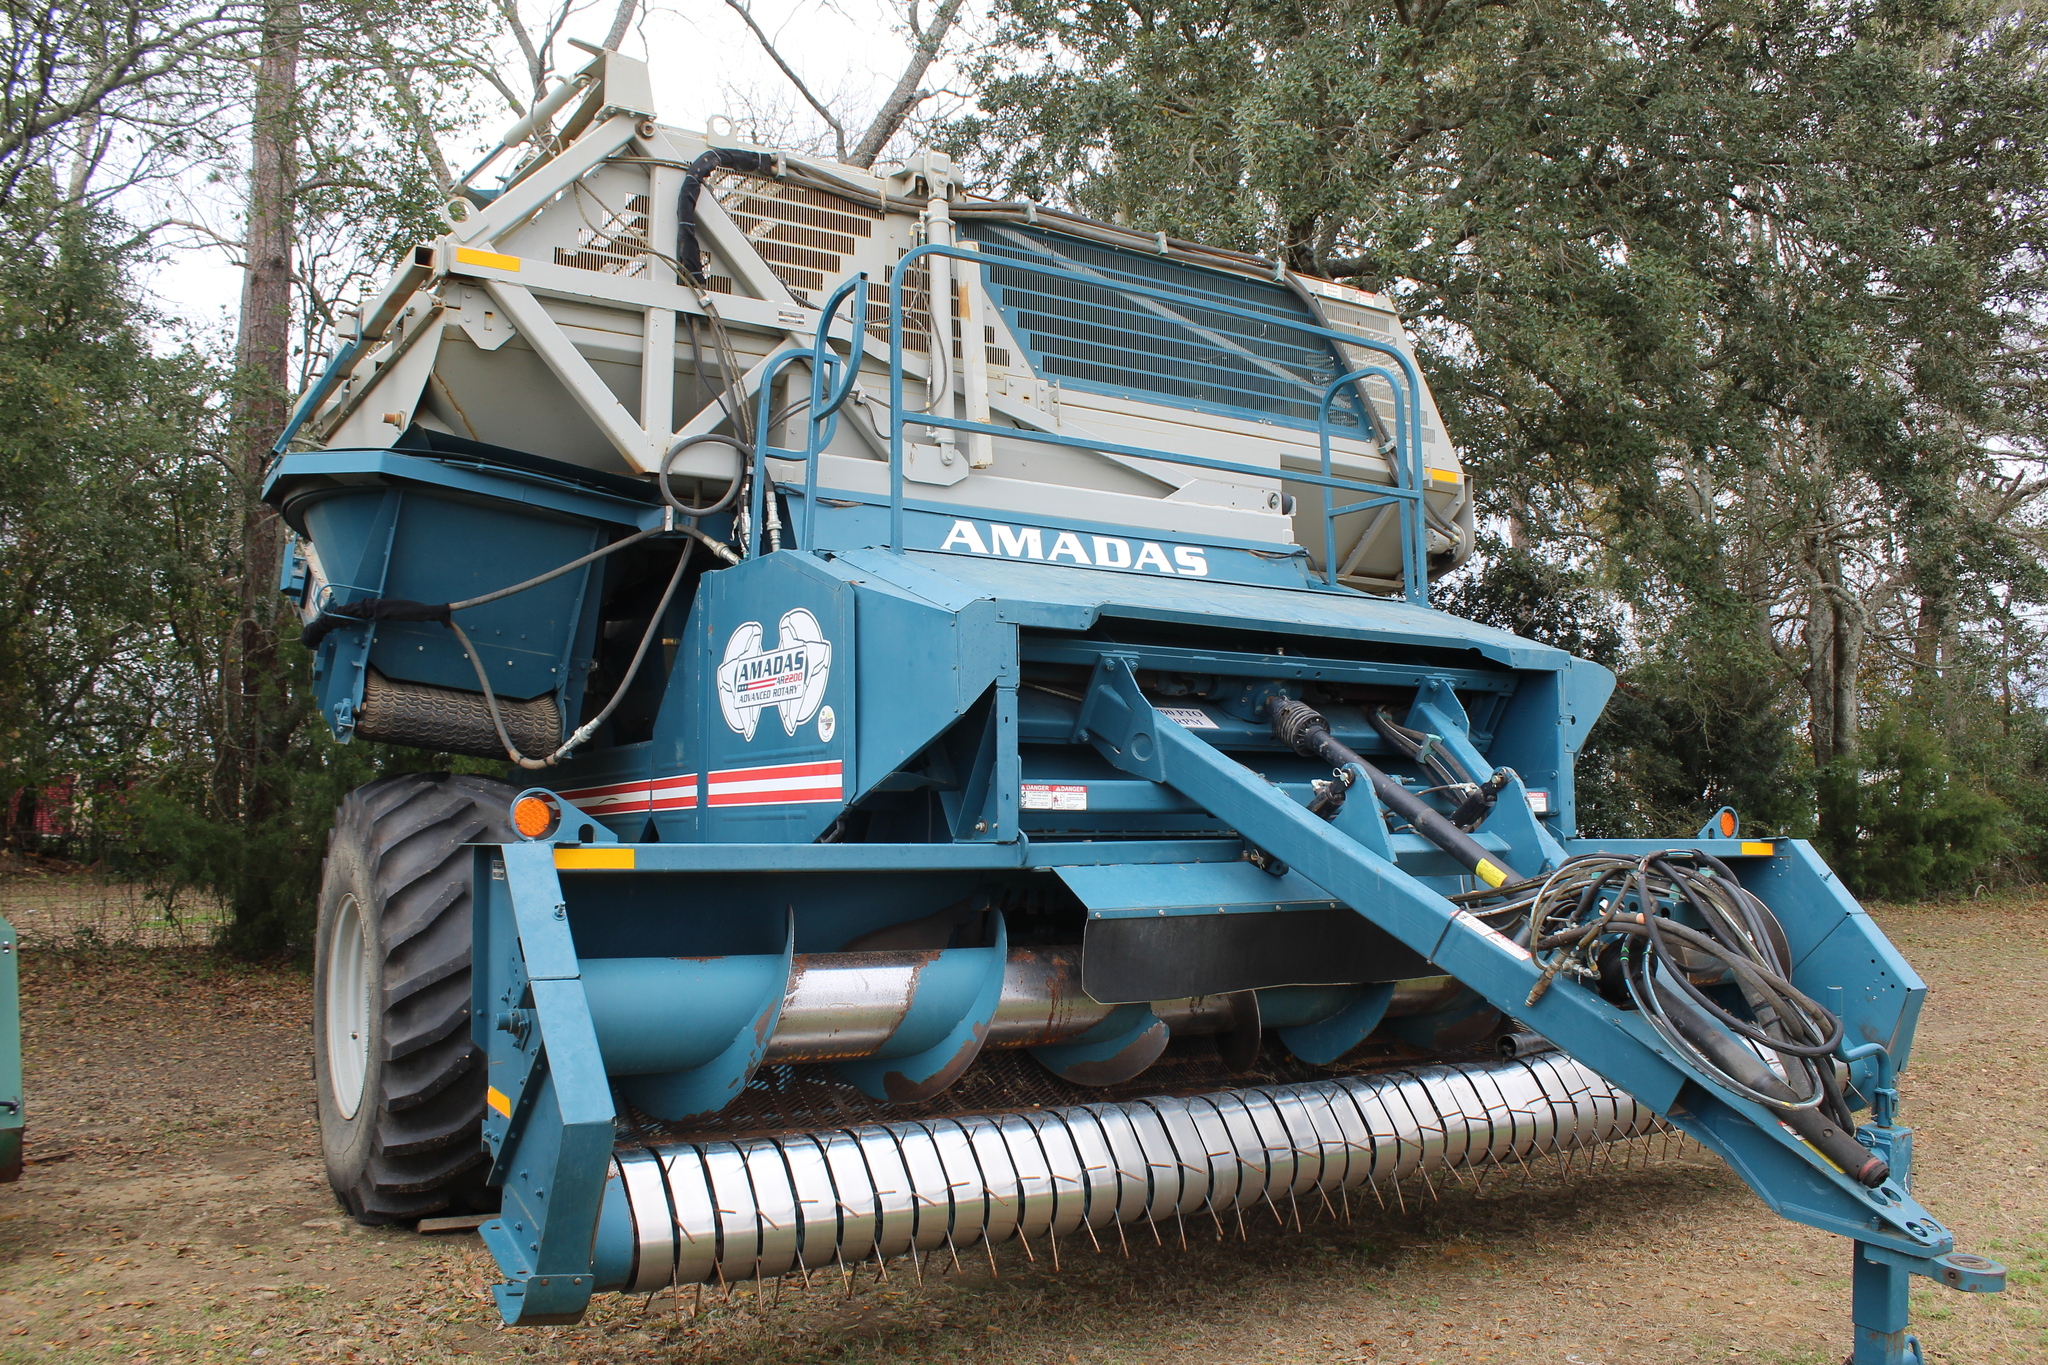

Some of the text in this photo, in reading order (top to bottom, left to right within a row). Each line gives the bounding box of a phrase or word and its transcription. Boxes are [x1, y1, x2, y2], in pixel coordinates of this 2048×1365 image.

[939, 519, 1209, 577] AMADAS
[738, 651, 804, 682] AMADAS
[777, 672, 803, 685] AR2200
[739, 690, 771, 703] ADVANCED
[1176, 709, 1203, 717] PTO
[1173, 718, 1204, 726] RPM
